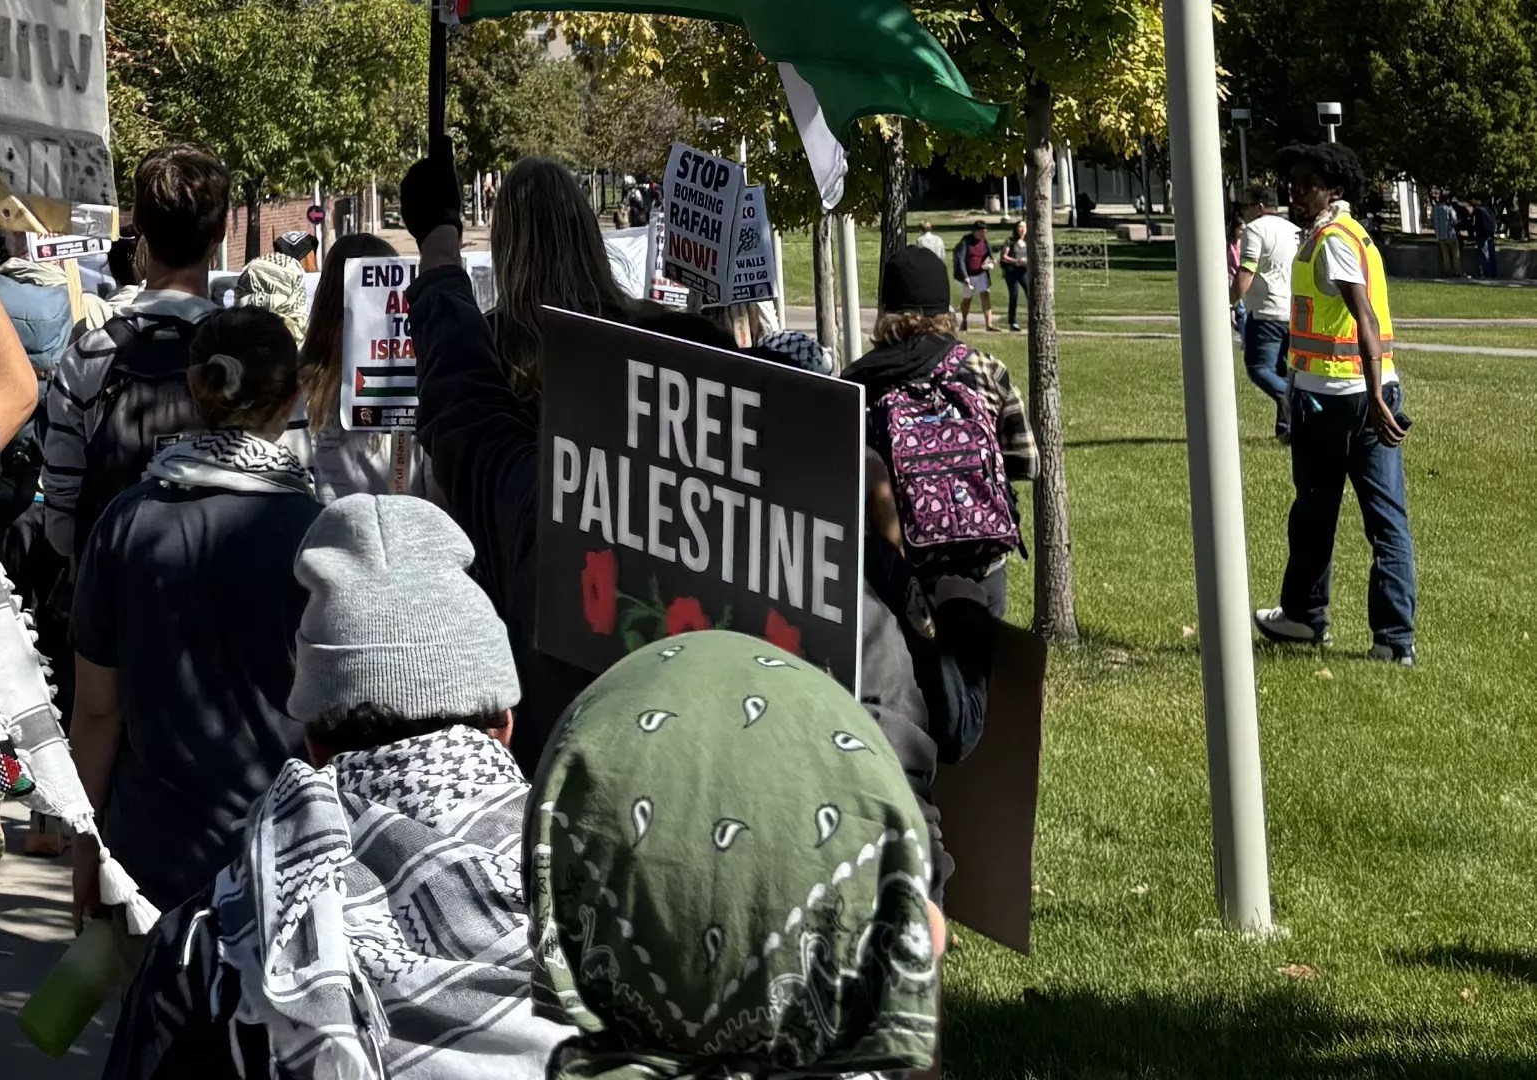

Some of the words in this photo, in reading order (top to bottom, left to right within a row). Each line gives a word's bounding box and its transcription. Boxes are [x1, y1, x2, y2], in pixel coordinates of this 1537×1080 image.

[676, 150, 730, 193] STOP
[673, 182, 724, 215] BOMBING
[669, 201, 723, 244] RAFAH
[668, 230, 718, 276] NOW!
[735, 256, 766, 269] WALLS
[361, 264, 404, 287] END
[626, 358, 762, 488] FREE
[551, 434, 845, 625] PALESTINE
